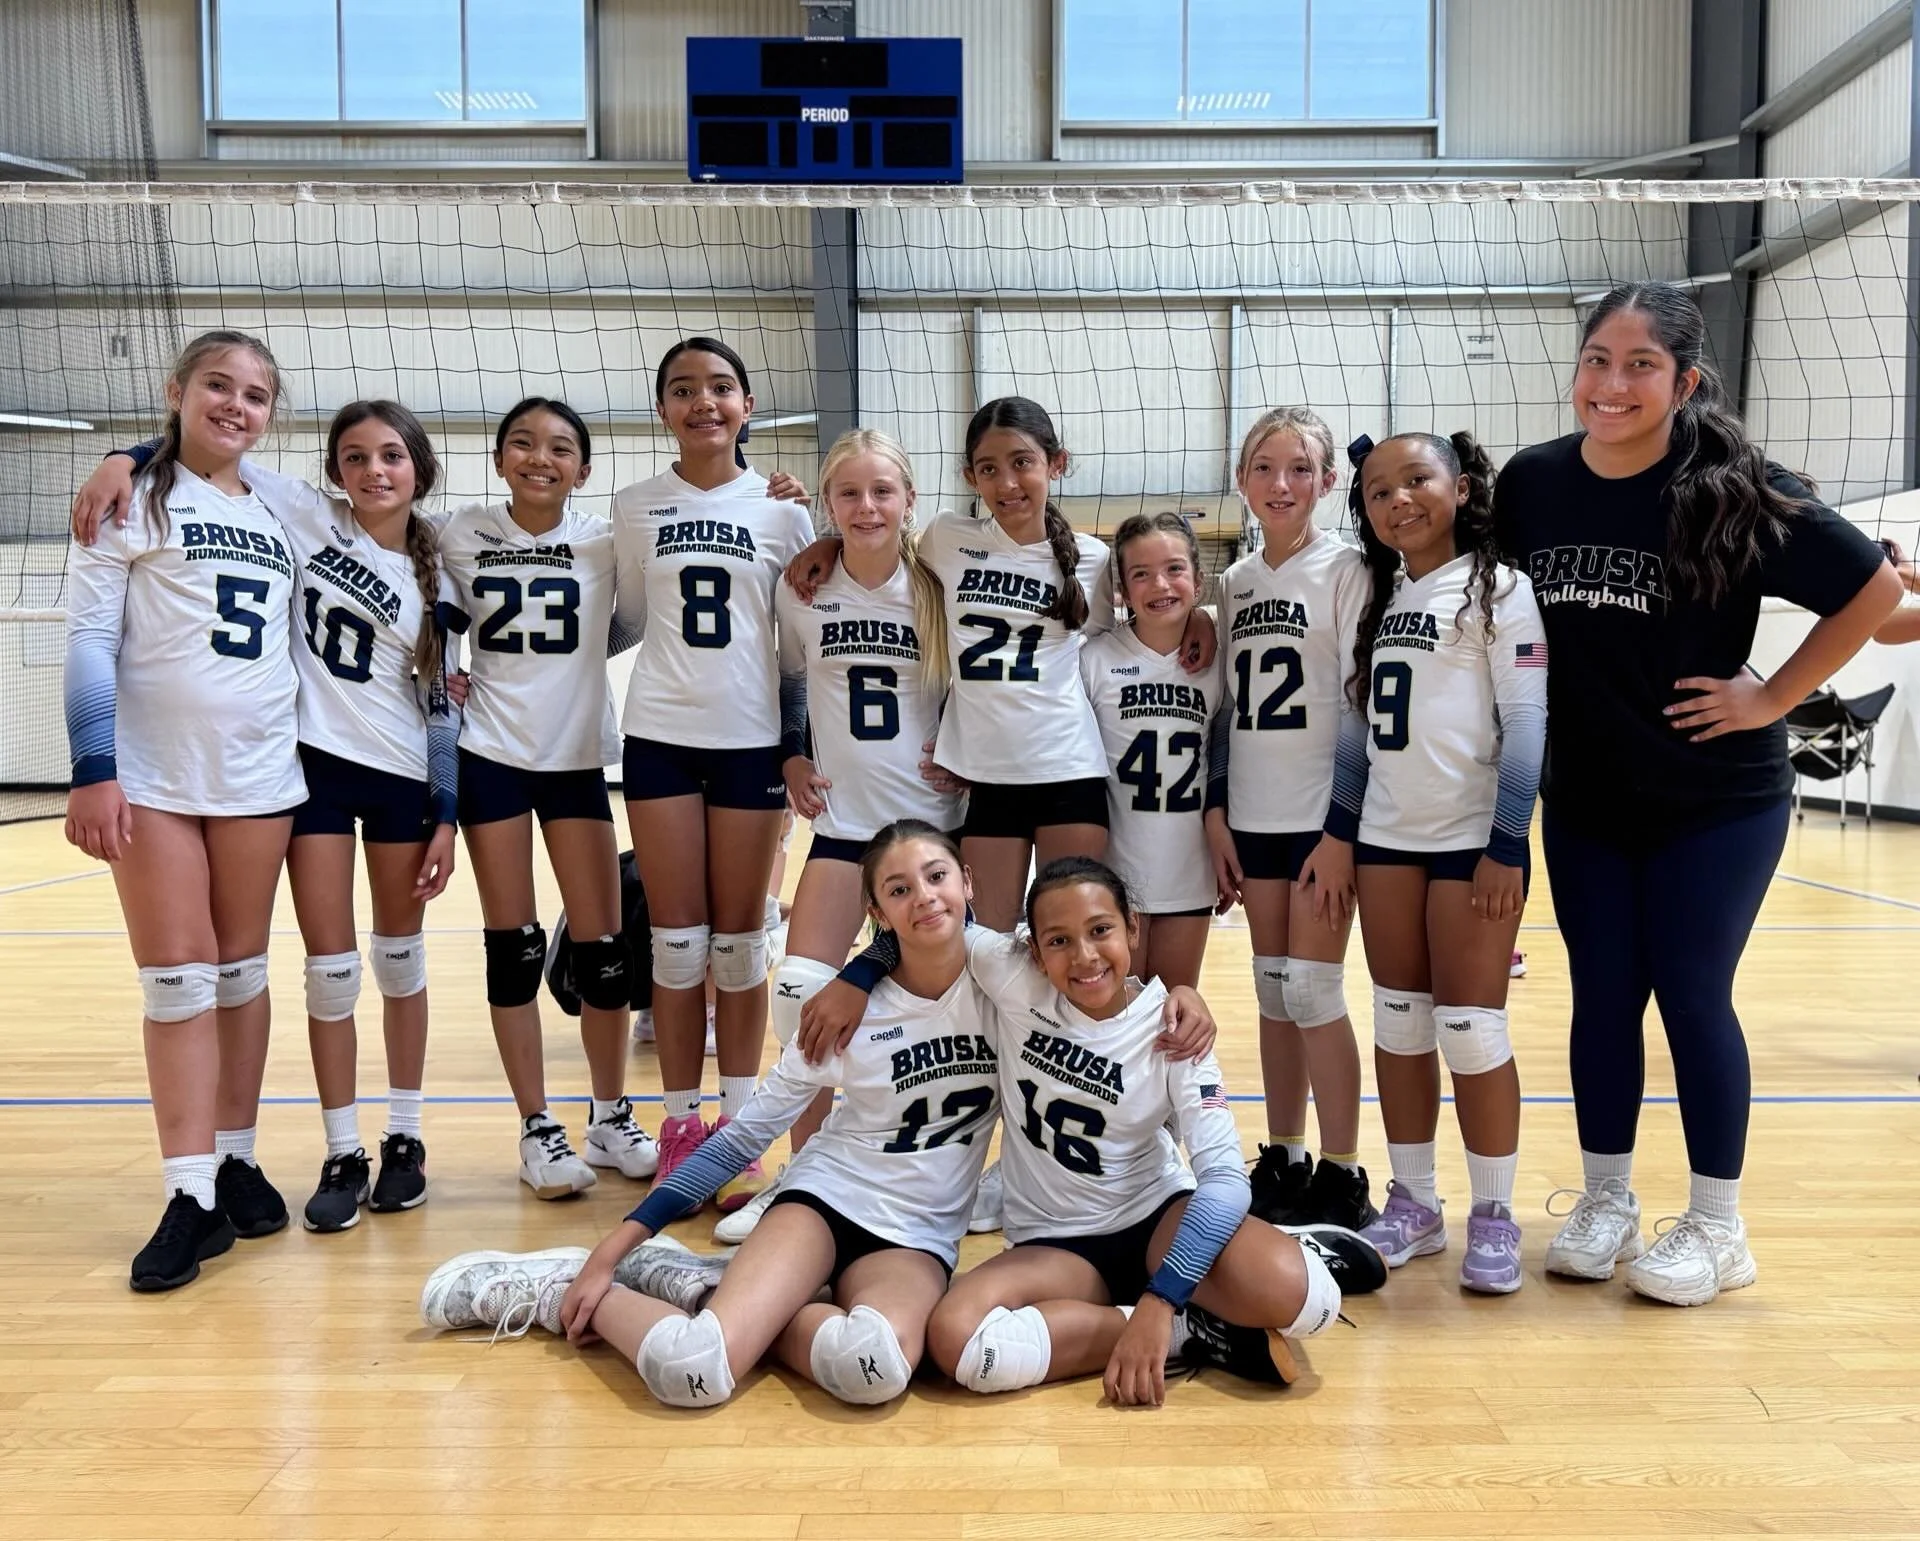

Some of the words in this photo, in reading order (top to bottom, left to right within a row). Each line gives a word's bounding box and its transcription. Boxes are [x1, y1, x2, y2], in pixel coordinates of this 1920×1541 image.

[801, 107, 849, 123] PERIOD
[168, 506, 196, 514] apelli
[649, 506, 677, 516] capelli
[181, 522, 291, 567] BRUSA
[655, 520, 756, 552] BRUSA
[656, 543, 754, 562] HUMMINGBIRDS
[185, 548, 291, 580] HUMMINGBIRDS
[478, 556, 572, 570] HUMMINGBIRDS
[1530, 545, 1672, 600] BRUSA
[305, 562, 390, 627] HUMMINGBIRDS
[311, 545, 402, 624] BRUSA
[956, 568, 1060, 607] BRUSA
[1536, 583, 1651, 614] Volleyball
[211, 574, 270, 660] 5
[472, 576, 580, 654] 23
[679, 565, 732, 649] 8
[1231, 599, 1308, 632] BRUSA
[1378, 612, 1439, 640] RUSA
[303, 586, 376, 684] 10
[820, 620, 920, 650] BRUSA
[821, 645, 920, 661] HUMMINGBIRDS
[958, 613, 1044, 682] 21
[1110, 666, 1140, 675] capelli
[1235, 646, 1307, 730] 12
[847, 666, 900, 740] 6
[1118, 683, 1207, 715] BRUSA
[1120, 707, 1205, 725] HUMMINGBIRDS
[1372, 661, 1412, 751] 9
[1116, 729, 1202, 812] 42
[870, 1026, 903, 1041] capelli
[891, 1035, 998, 1082] BRUSA
[895, 1064, 998, 1094] HUMMINGBIRDS
[1020, 1050, 1119, 1105] HUMMINGBIRDS
[1023, 1030, 1125, 1094] BRUSA
[883, 1085, 995, 1153] 12
[1016, 1079, 1106, 1176] 16
